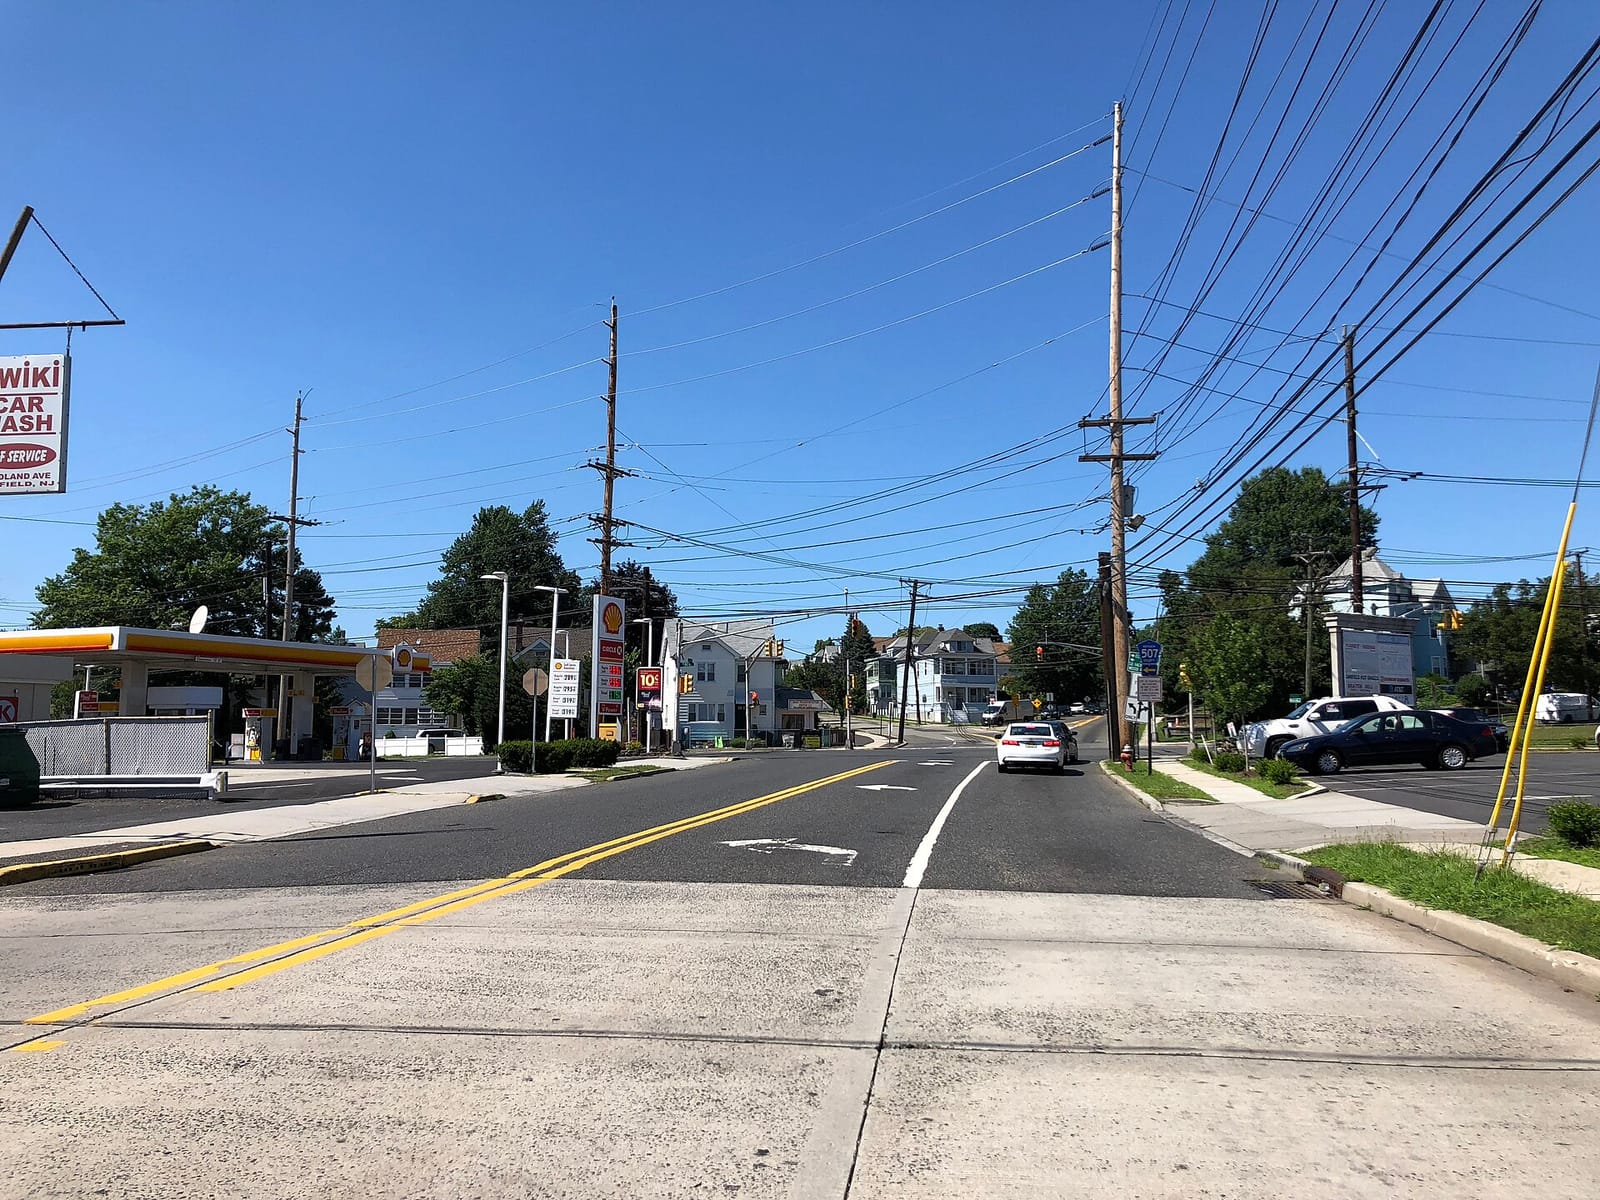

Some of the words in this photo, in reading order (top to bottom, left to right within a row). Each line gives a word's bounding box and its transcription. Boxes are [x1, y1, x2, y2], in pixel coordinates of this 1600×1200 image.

[0, 396, 44, 413] CAR
[0, 414, 53, 432] ASH
[7, 449, 48, 463] SERVICE
[32, 472, 51, 480] AVE
[1141, 648, 1158, 659] 507
[0, 705, 12, 722] K
